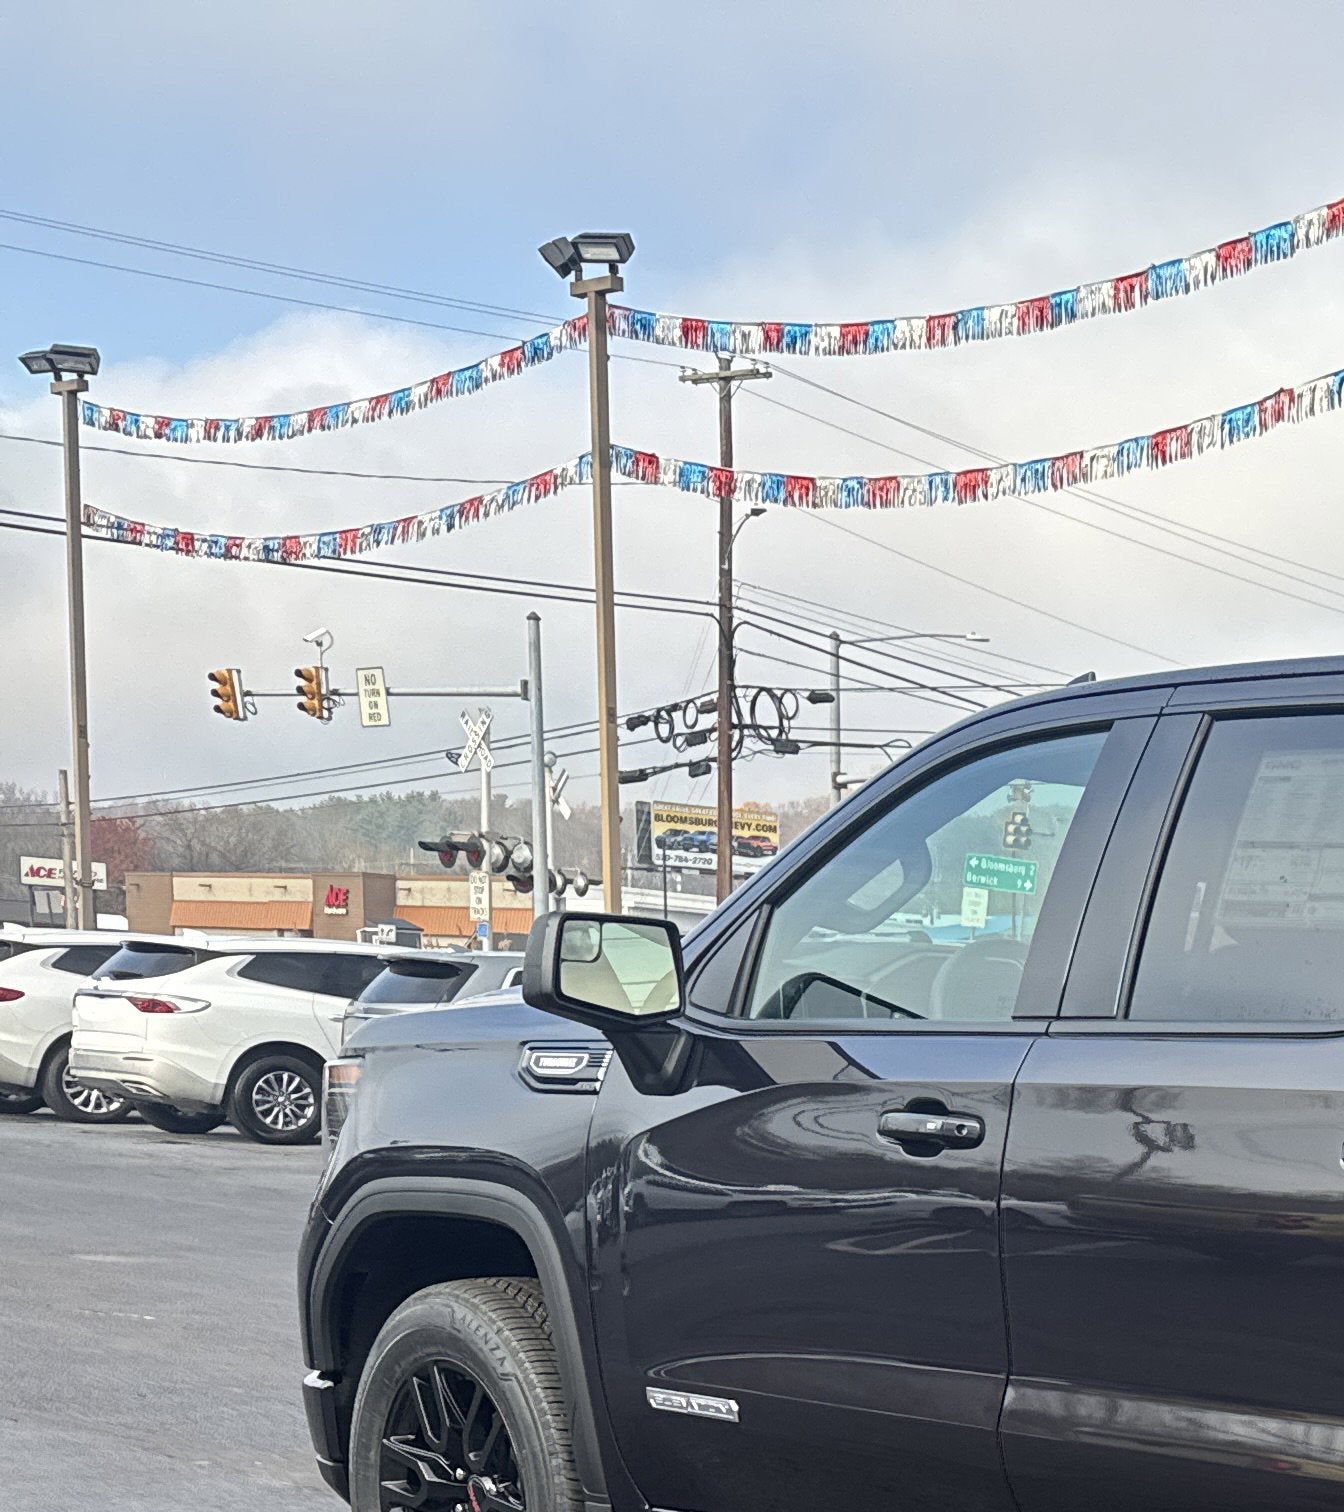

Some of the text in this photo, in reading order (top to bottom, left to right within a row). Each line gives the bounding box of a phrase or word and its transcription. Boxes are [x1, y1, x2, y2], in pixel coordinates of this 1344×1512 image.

[364, 673, 377, 686] NO
[364, 688, 381, 698] TURN
[368, 700, 379, 710] ON
[368, 712, 382, 722] RED
[24, 864, 58, 879] ACE
[1029, 865, 1036, 876] 2
[966, 871, 1022, 888] Berwick 9
